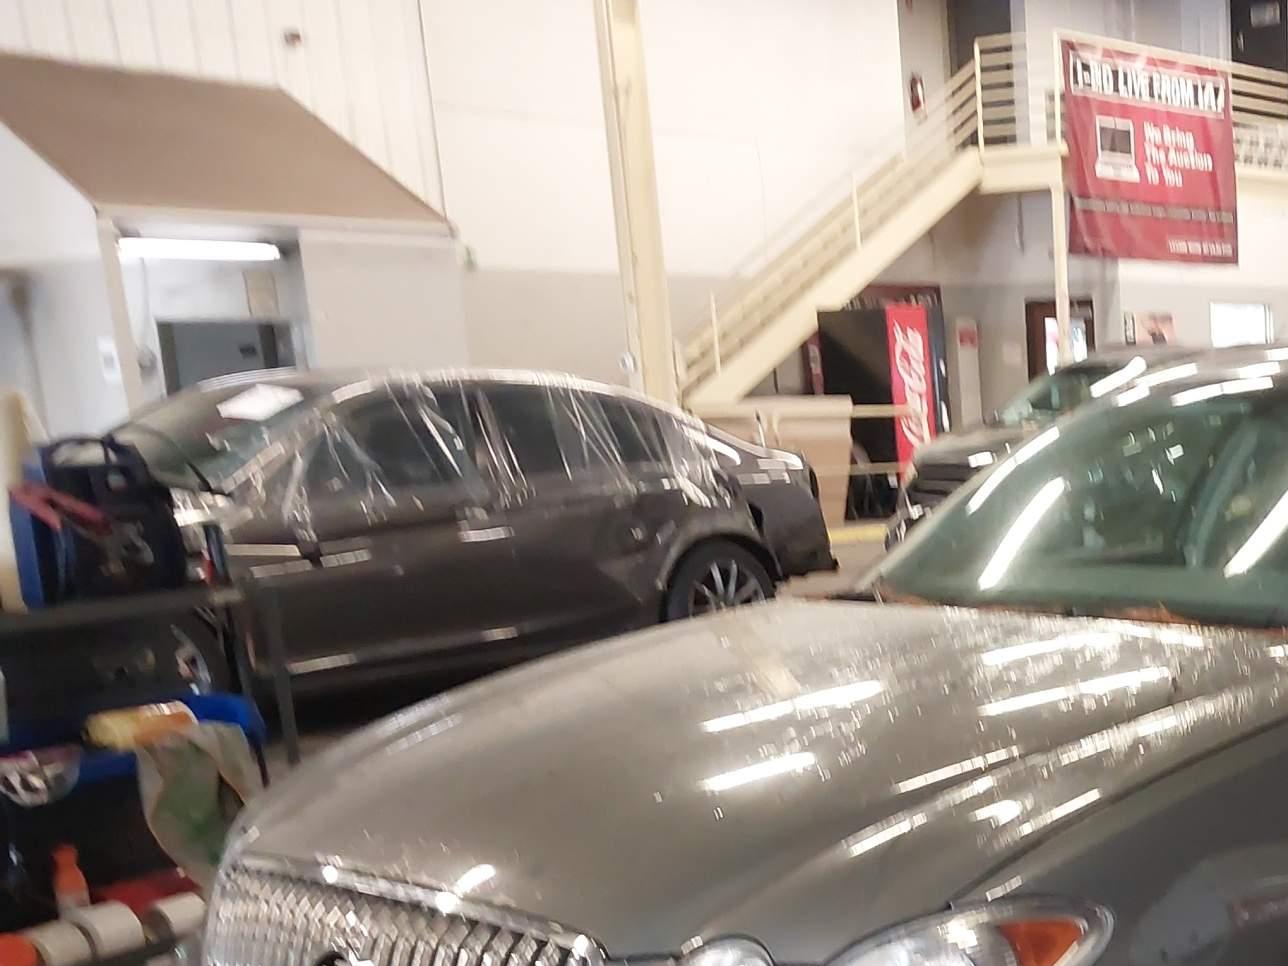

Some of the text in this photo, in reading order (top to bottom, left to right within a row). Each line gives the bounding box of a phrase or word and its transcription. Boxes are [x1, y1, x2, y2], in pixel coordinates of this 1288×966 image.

[1118, 62, 1151, 101] LIVE
[1151, 70, 1195, 110] FROM
[1143, 141, 1213, 172] The Auction
[1143, 161, 1183, 188] To You
